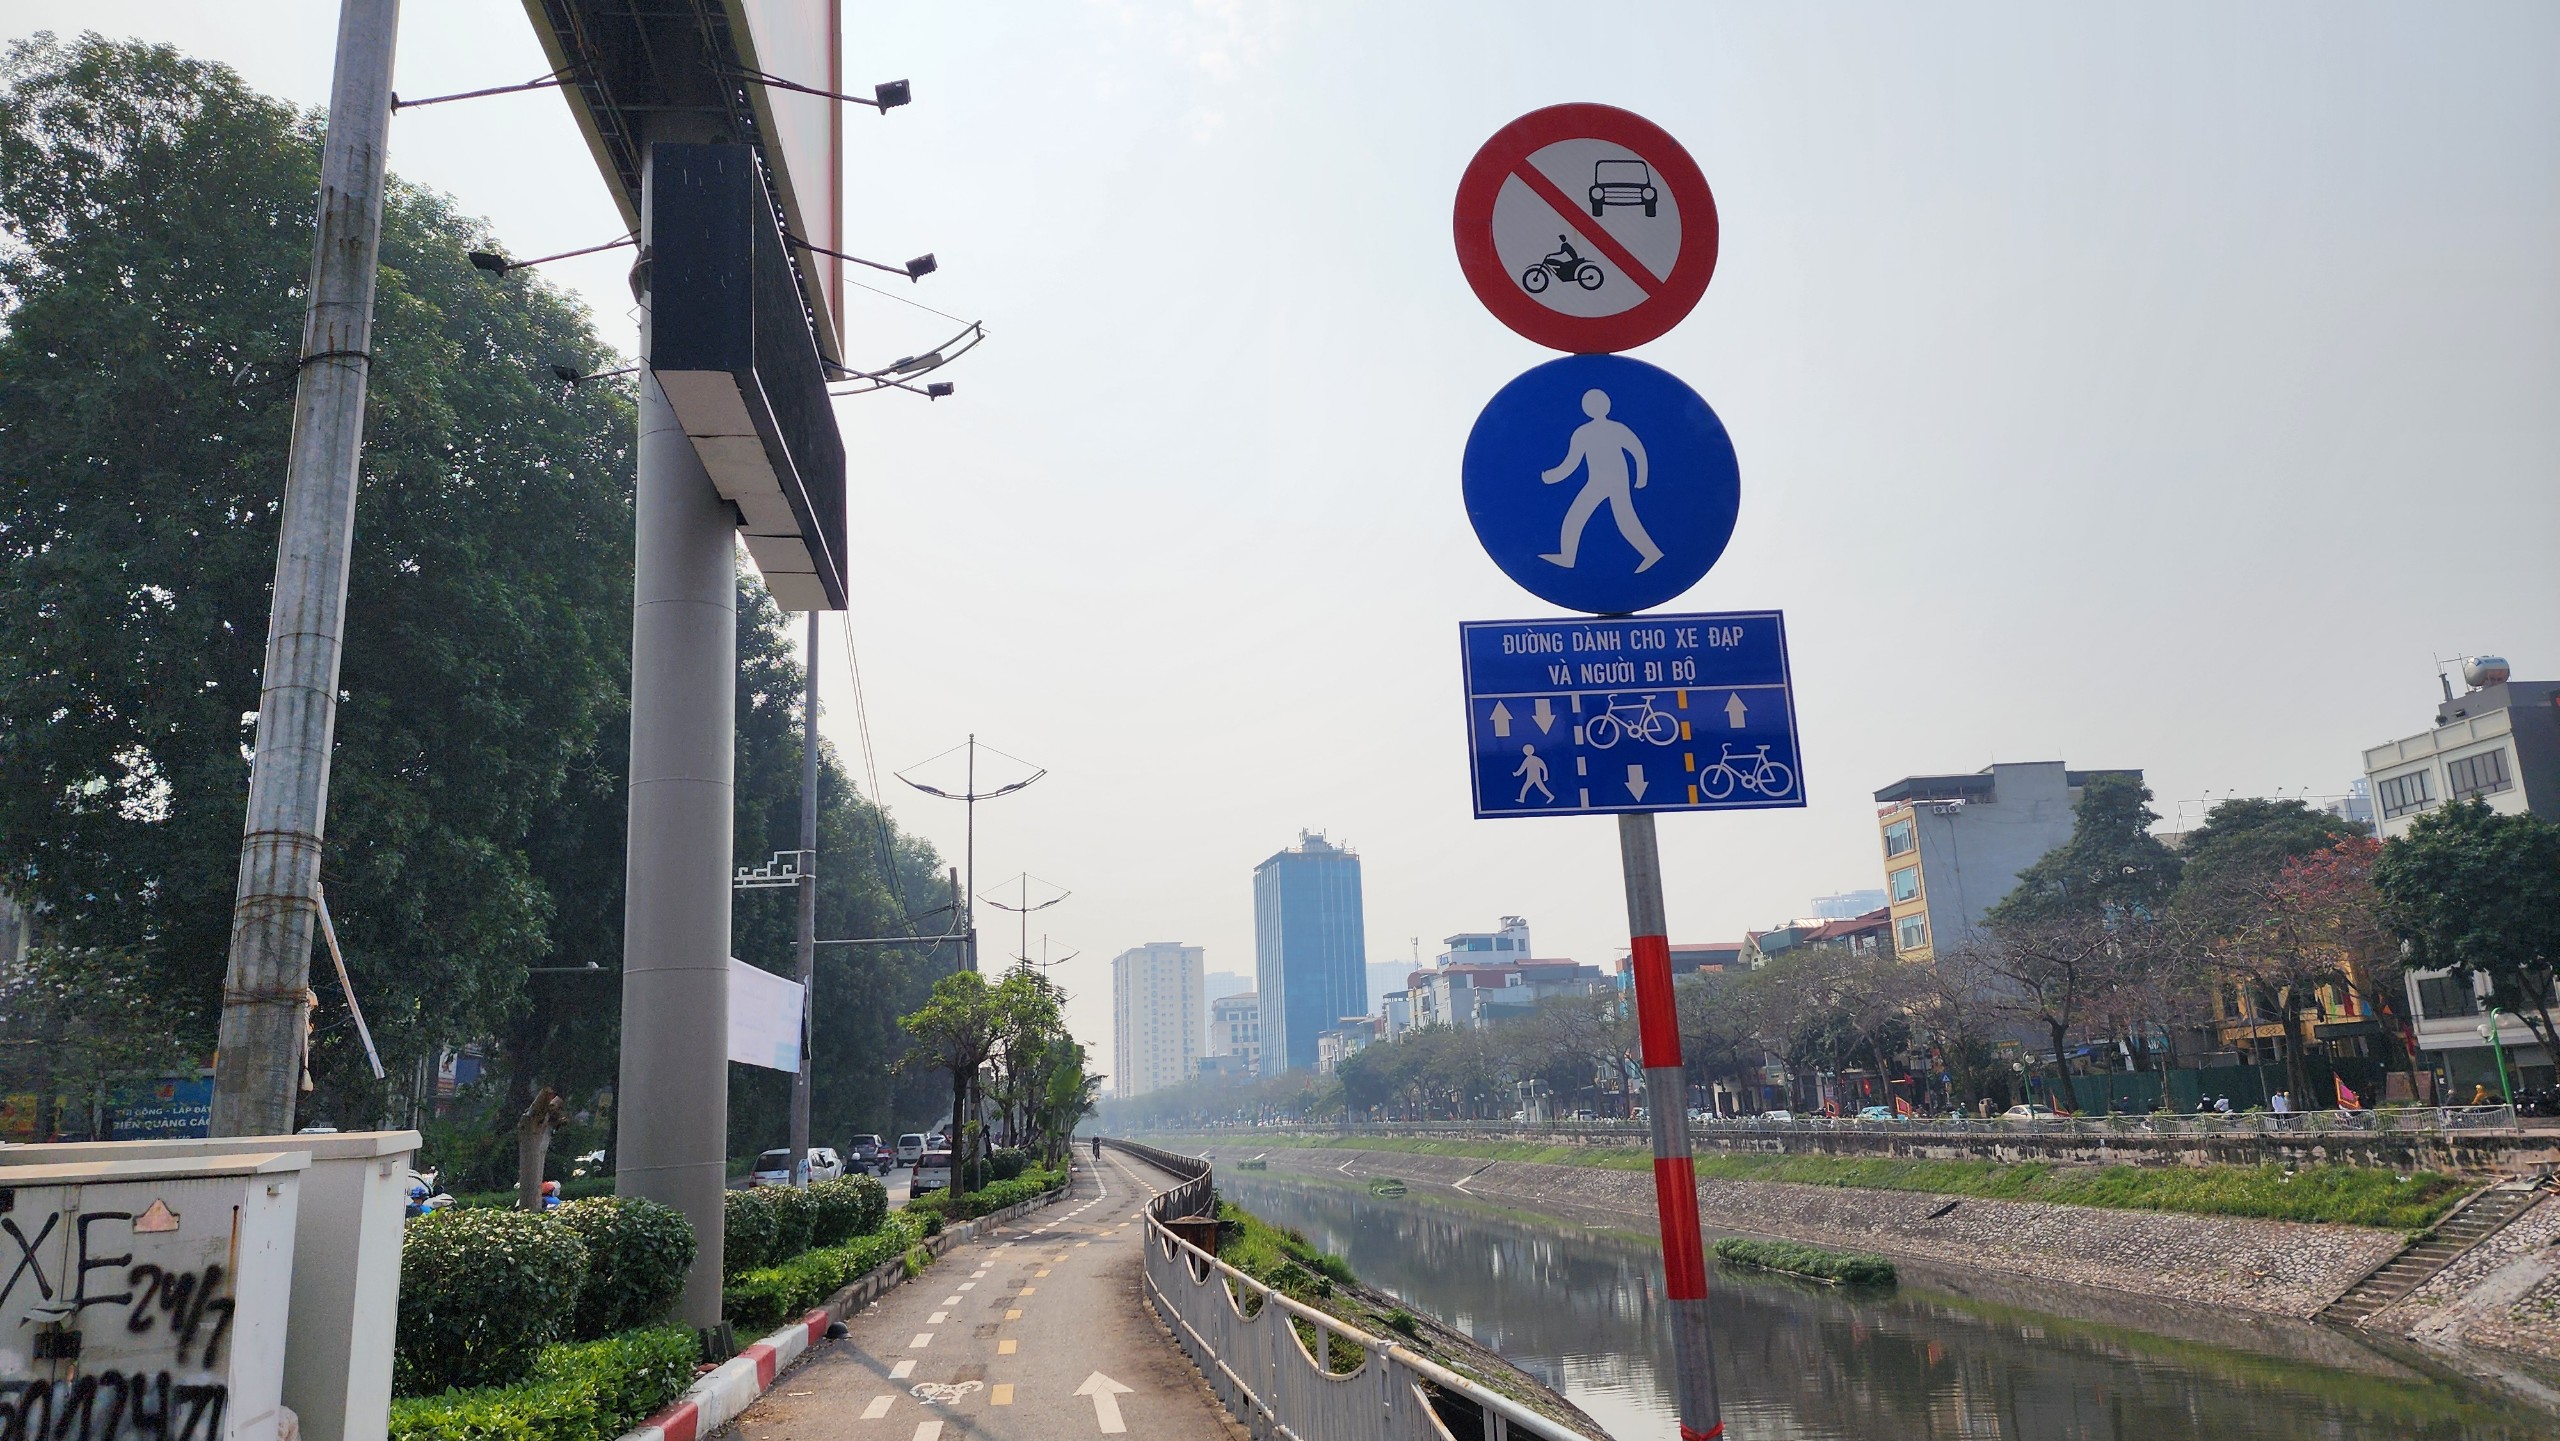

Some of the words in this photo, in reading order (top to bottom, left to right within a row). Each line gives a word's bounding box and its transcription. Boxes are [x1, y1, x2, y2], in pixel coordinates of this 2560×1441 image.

[1502, 628, 1563, 655] ĐƯỜNG
[1572, 625, 1621, 652] DÀNH
[1630, 628, 1666, 650] CHO
[1674, 627, 1699, 649] XE
[1707, 626, 1744, 651] ĐẠP
[1548, 658, 1573, 685] VÀ
[1580, 655, 1635, 684] NGƯỜI
[1643, 661, 1663, 682] ĐI
[1671, 655, 1696, 685] BỘ
[0, 1211, 134, 1310] XE
